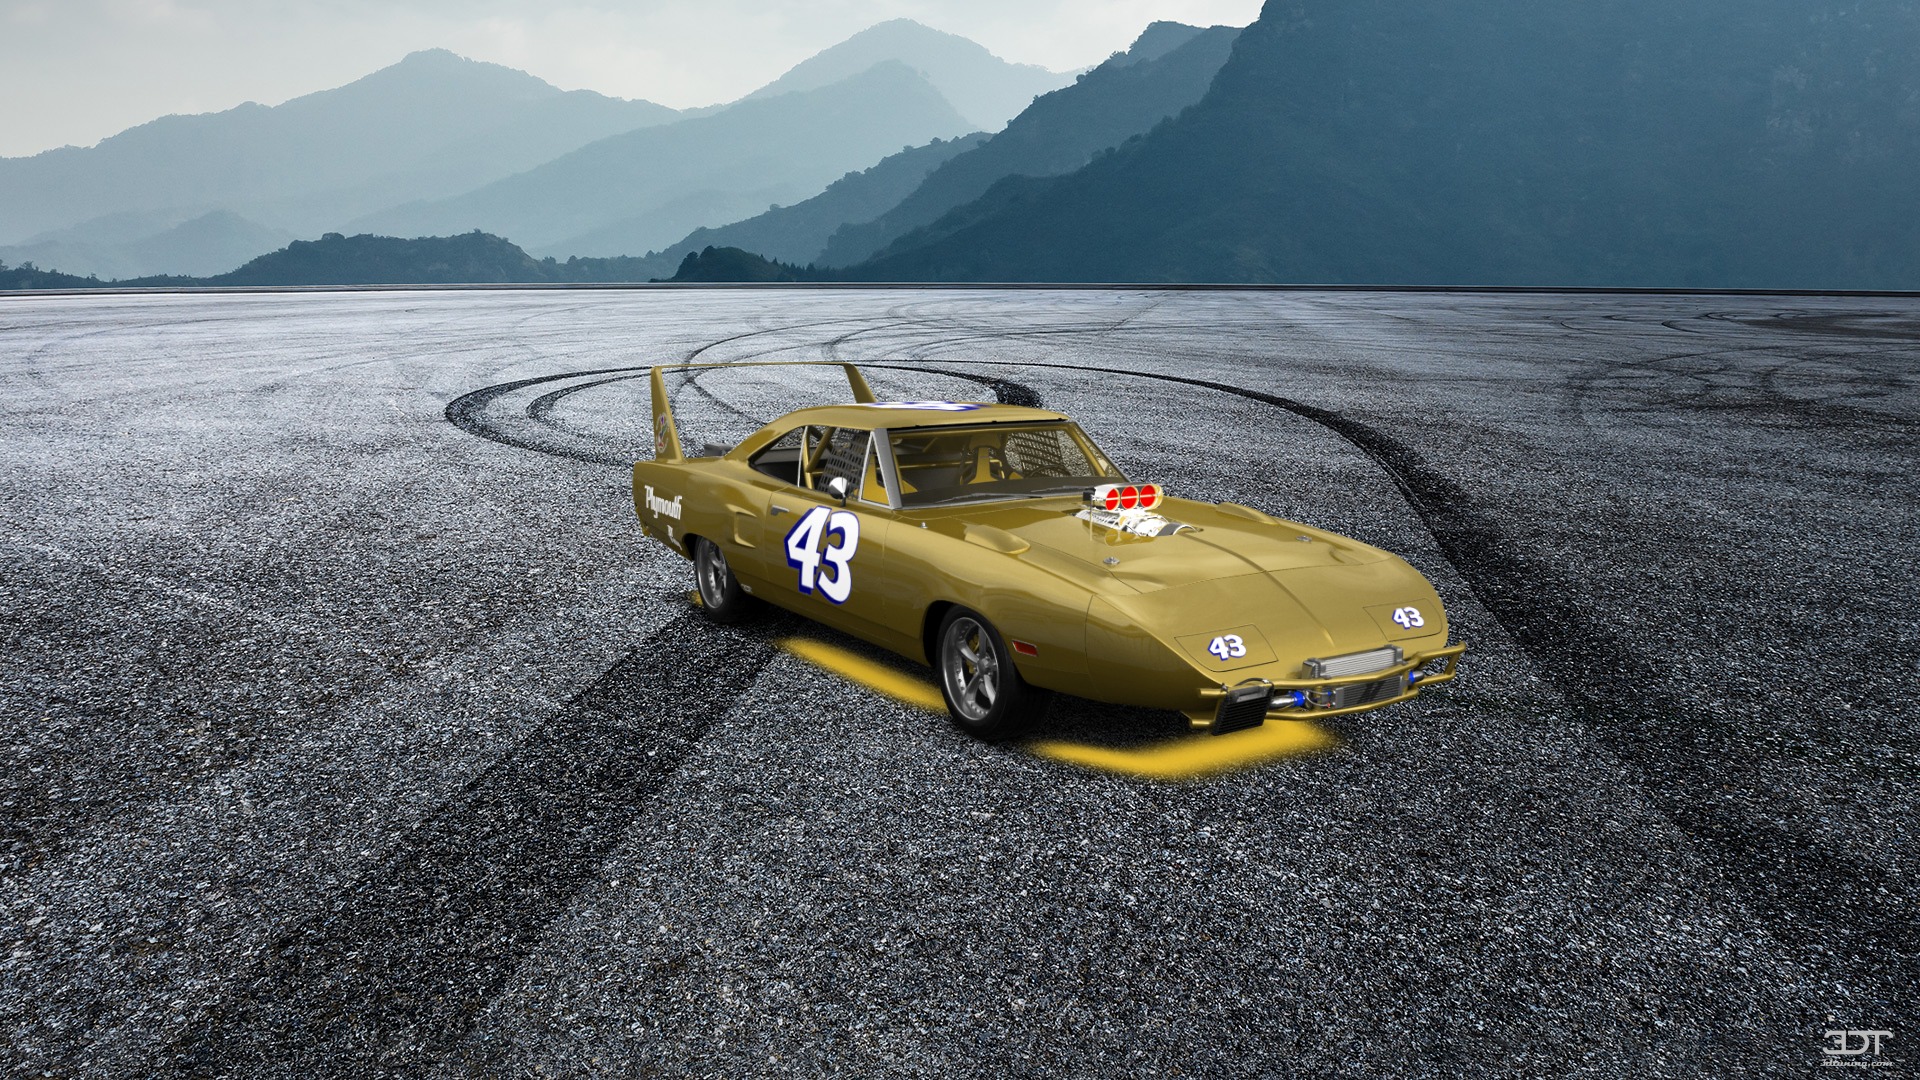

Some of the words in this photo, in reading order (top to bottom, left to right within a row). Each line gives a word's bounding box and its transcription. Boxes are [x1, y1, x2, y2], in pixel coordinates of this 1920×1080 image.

[644, 484, 683, 520] Plymouth
[784, 505, 861, 605] 43
[1392, 606, 1425, 630] 43
[1207, 634, 1247, 661] 43
